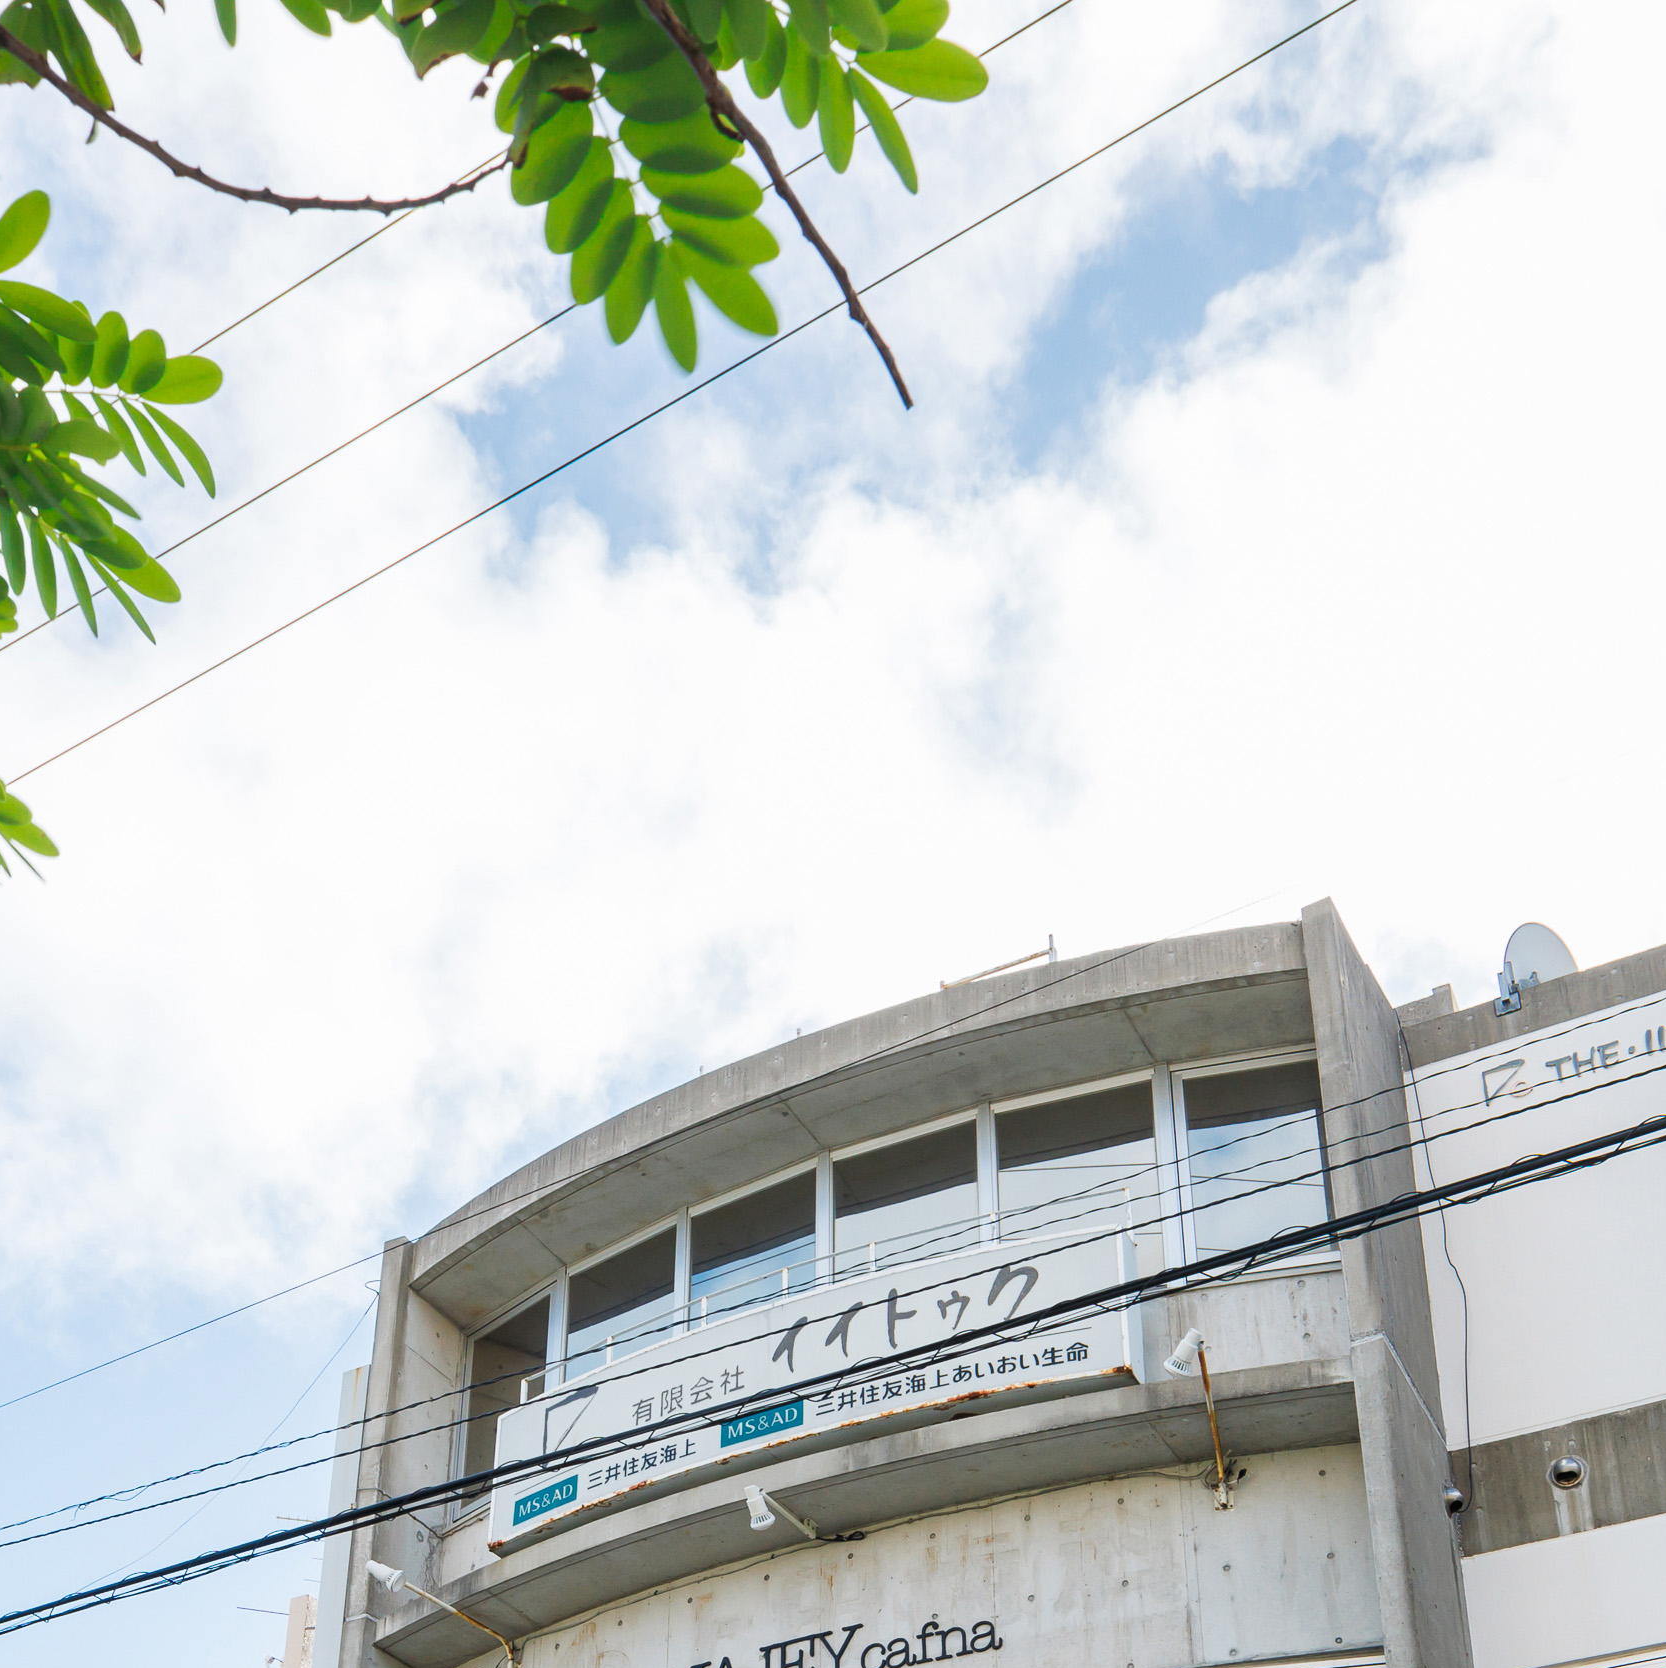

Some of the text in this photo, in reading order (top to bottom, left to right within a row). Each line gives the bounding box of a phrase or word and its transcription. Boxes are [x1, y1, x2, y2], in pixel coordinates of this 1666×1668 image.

[632, 1265, 1039, 1426] 有限会社 イイトゥク
[728, 1341, 1090, 1439] MS&AD 三井住友海上あいおい生命
[519, 1439, 696, 1518] MS&AD 三井住友海上
